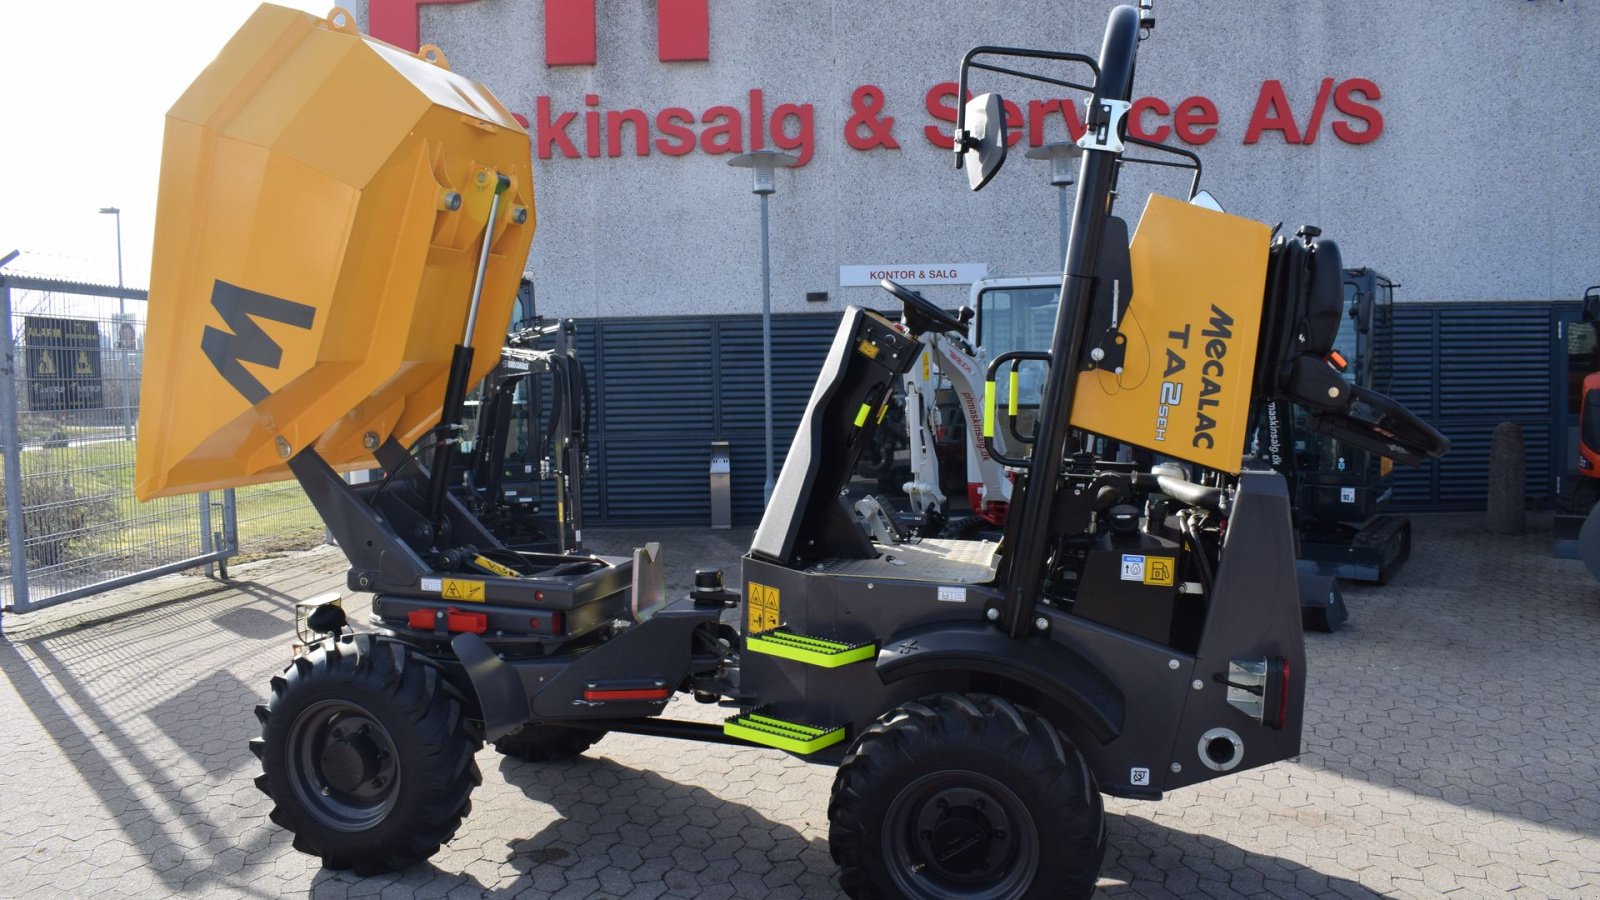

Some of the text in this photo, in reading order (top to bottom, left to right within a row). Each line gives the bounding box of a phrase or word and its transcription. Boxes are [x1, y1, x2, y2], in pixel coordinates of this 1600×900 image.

[511, 88, 815, 169] kinsalg
[844, 84, 900, 150] &
[1243, 77, 1385, 146] A/S
[869, 269, 958, 280] KONTOR & SALG
[1267, 397, 1282, 466] maskinsalg.dk
